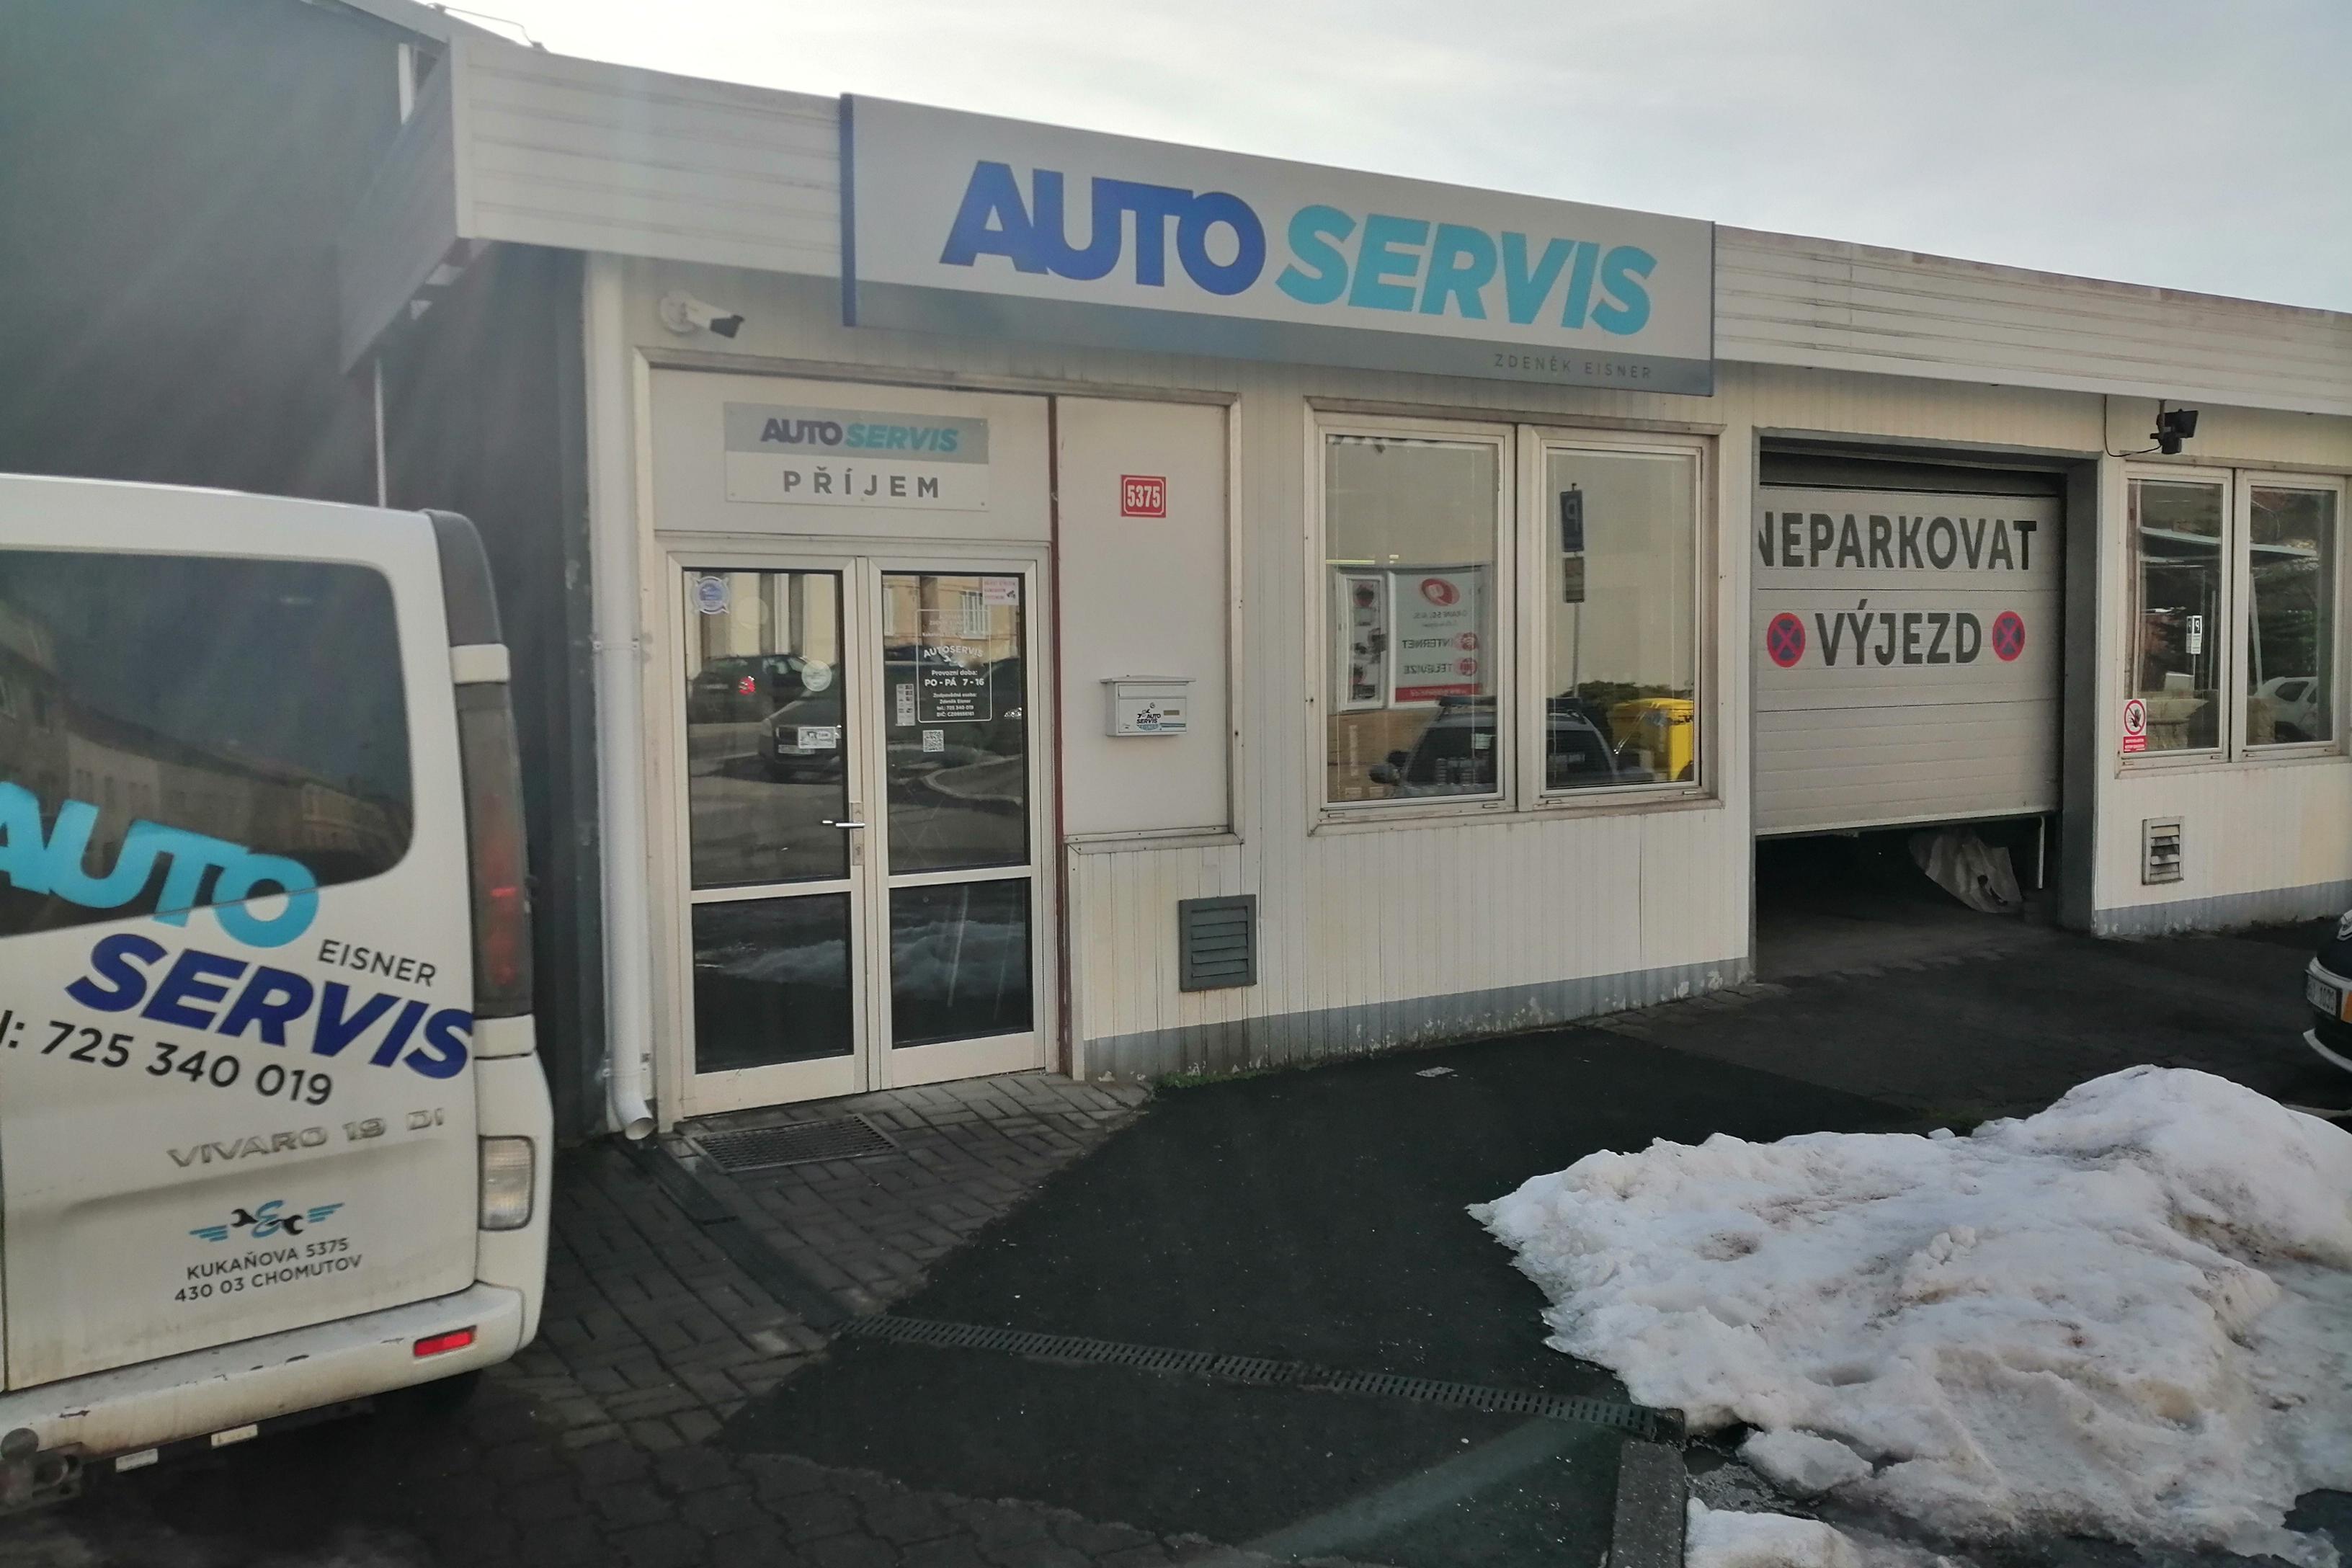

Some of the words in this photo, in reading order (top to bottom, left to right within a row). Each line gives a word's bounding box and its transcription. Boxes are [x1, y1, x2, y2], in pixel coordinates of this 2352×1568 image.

[939, 160, 1267, 296] AUTO
[1275, 203, 1658, 336] SERVIS
[1494, 353, 1572, 373] ZDENĚK
[1585, 361, 1652, 379] EISNER
[760, 418, 843, 446] AUTO
[845, 422, 959, 453] SERVIS
[783, 466, 939, 498] PŘÍJEM
[1127, 484, 1161, 508] 5375
[1758, 511, 2037, 571] NEPARKOVAT
[923, 645, 984, 659] AUTOSERVIS
[1814, 598, 1982, 667] VÝJEZD
[925, 678, 937, 687] PO
[945, 677, 958, 687] PÁ
[0, 781, 319, 948] AUTO
[318, 939, 437, 988] EISNER
[64, 932, 473, 1079] SERVIS
[40, 1020, 134, 1069] 725
[146, 1041, 240, 1089] 340
[255, 1064, 333, 1106] 019
[166, 1126, 329, 1167] VIVARO
[406, 1107, 445, 1131] DI
[174, 1283, 213, 1303] 430
[220, 1277, 245, 1294] 03
[251, 1254, 362, 1288] CHOMUTOV
[187, 1247, 298, 1280] KUKAŇOVA
[306, 1237, 349, 1257] 5375
